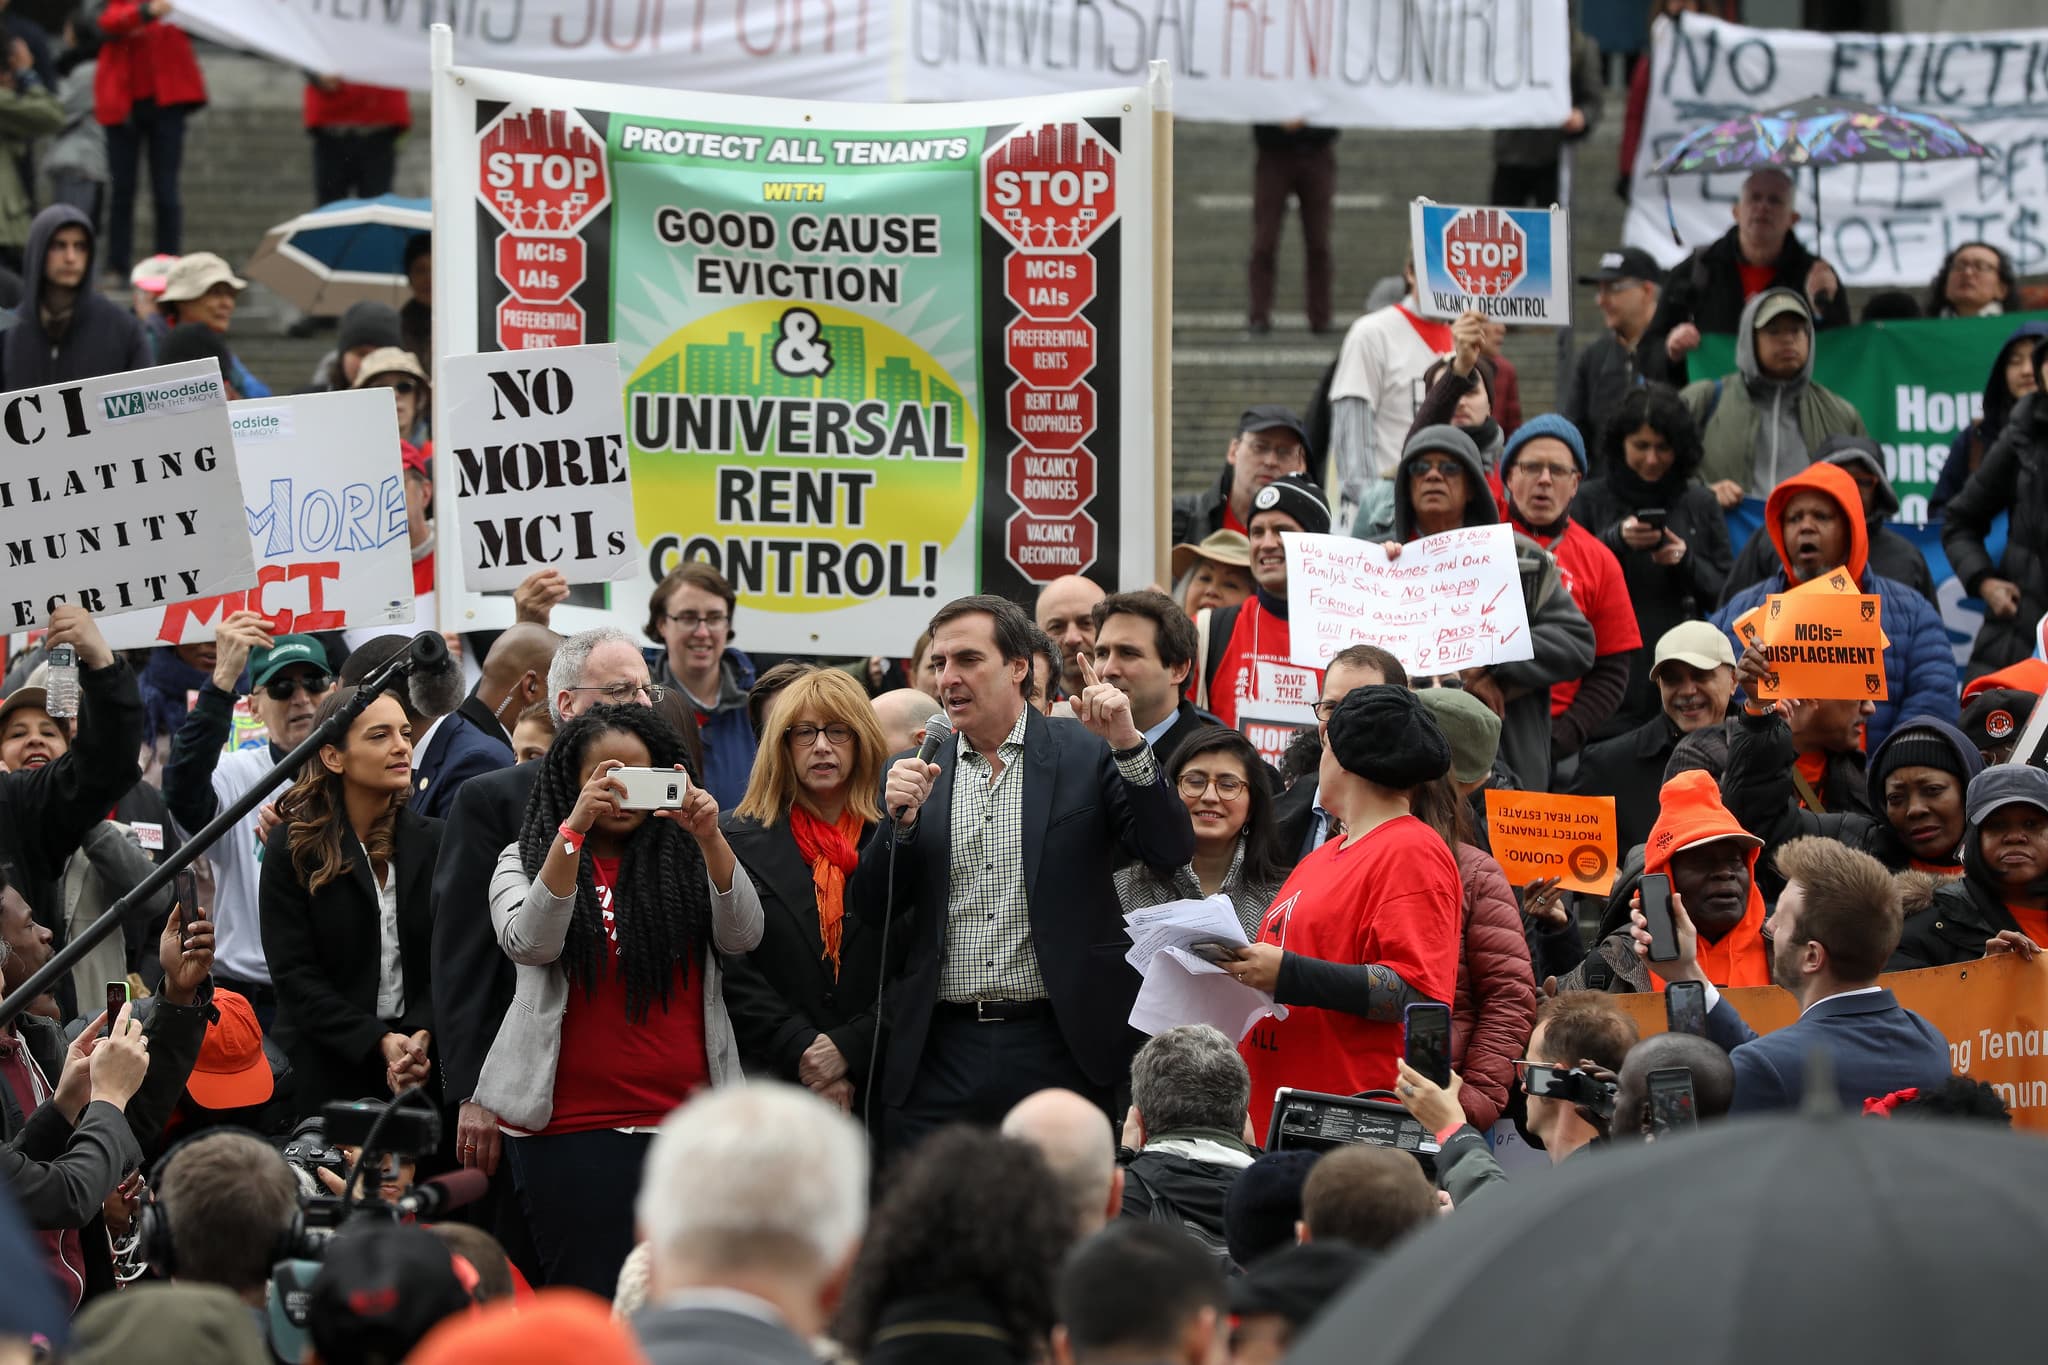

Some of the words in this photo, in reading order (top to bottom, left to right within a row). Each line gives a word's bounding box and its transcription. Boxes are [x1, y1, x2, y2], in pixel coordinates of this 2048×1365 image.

[1663, 20, 1778, 95] NO
[622, 125, 762, 161] PROTECT
[766, 138, 825, 164] ALL
[833, 137, 968, 165] TENANTS
[487, 152, 598, 190] STOP
[763, 182, 825, 202] WITH
[994, 170, 1110, 206] STOP
[657, 208, 776, 251] GOOD
[791, 216, 938, 254] CAUSE
[516, 243, 567, 262] MCIs
[1451, 241, 1519, 268] STOP
[519, 269, 560, 289] IAIs
[1026, 261, 1078, 279] MCIs
[697, 258, 898, 303] EVICTION
[1029, 288, 1070, 306] IAIs
[1433, 291, 1473, 314] VACANCY
[1478, 296, 1549, 319] DECONTROL
[503, 309, 578, 331] PREFERENTIAL
[523, 333, 557, 349] RENTS
[773, 307, 834, 378] &
[1012, 329, 1089, 347] PREFERENTIAL
[1033, 352, 1068, 369] RENTS
[146, 381, 218, 403] Woodside
[147, 401, 165, 411] ON
[168, 399, 185, 408] THE
[188, 392, 220, 405] MOVE
[487, 367, 574, 421] NO
[1025, 393, 1053, 411] RENT
[1056, 394, 1079, 411] LAW
[634, 395, 965, 458] UNIVERSAL
[1022, 415, 1083, 433] LOOPHOLES
[453, 434, 627, 498] MORE
[1024, 457, 1079, 478] VACANCY
[0, 446, 217, 508] ILATING
[718, 468, 873, 526] RENT
[1023, 480, 1079, 501] BONUSES
[246, 475, 409, 558] MORE
[6, 509, 199, 568] MUNITY
[1026, 524, 1076, 543] VACANCY
[1019, 546, 1081, 565] DECONTROL
[1794, 623, 1843, 642] MCIs=
[1765, 645, 1876, 665] DISPLACEMENT
[1274, 673, 1307, 687] SAVE
[1276, 687, 1303, 700] THE
[1498, 807, 1542, 820] ESTATE!
[1544, 811, 1571, 823] REAL
[1575, 814, 1599, 825] NOT
[1496, 822, 1548, 838] TENANTS,
[1553, 830, 1602, 841] PROTECT
[1504, 848, 1564, 865] CUOMO:
[1251, 1027, 1279, 1052] ALL
